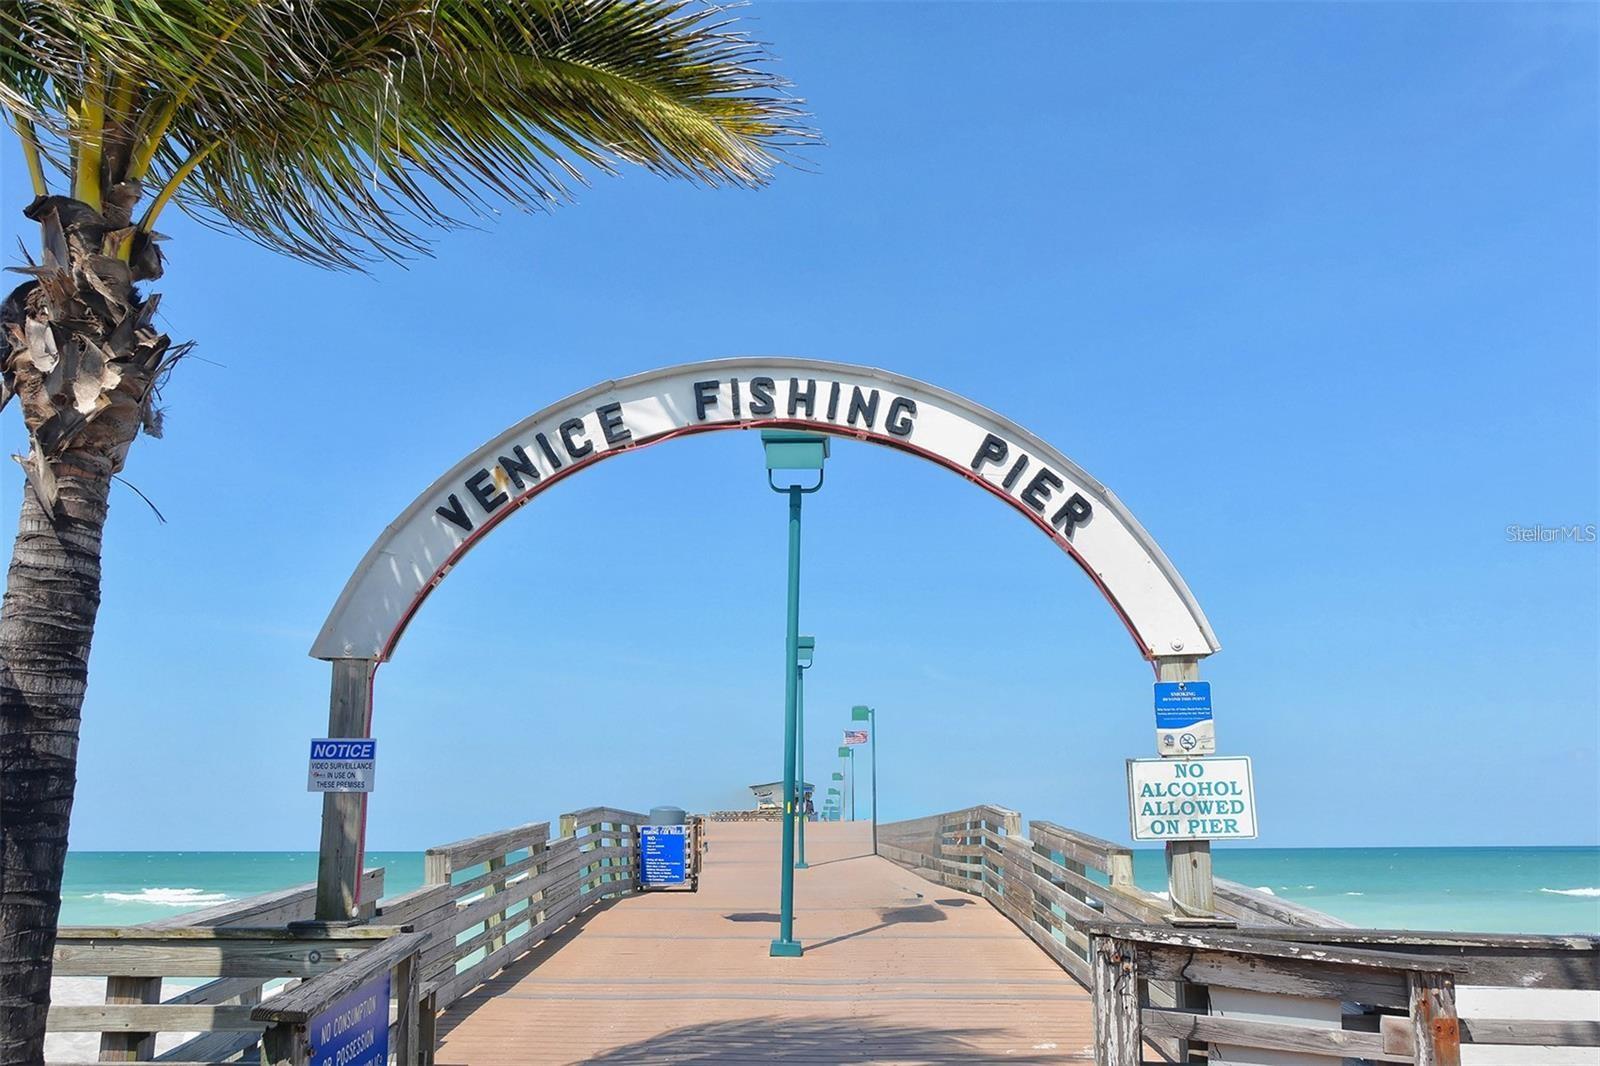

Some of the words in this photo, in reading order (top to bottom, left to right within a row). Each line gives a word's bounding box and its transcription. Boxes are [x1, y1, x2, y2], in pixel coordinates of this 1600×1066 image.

[435, 401, 632, 531] VENICE
[694, 376, 917, 436] FISHING
[970, 432, 1094, 539] PIER
[313, 744, 372, 758] NOTICE
[311, 762, 329, 770] VIDEO
[330, 762, 373, 770] SURVEILLANCE
[1174, 763, 1204, 779] NO
[326, 771, 333, 779] IN
[334, 771, 346, 779] USE
[346, 771, 356, 779] ON
[1140, 781, 1243, 797] ALCOHOL
[1141, 800, 1244, 816] ALLOWED
[1150, 820, 1180, 835] ON
[1187, 818, 1240, 834] PIER
[320, 1022, 332, 1046] NO
[333, 995, 377, 1037] CONSUMPTION
[336, 1027, 375, 1066] POSSESSION
